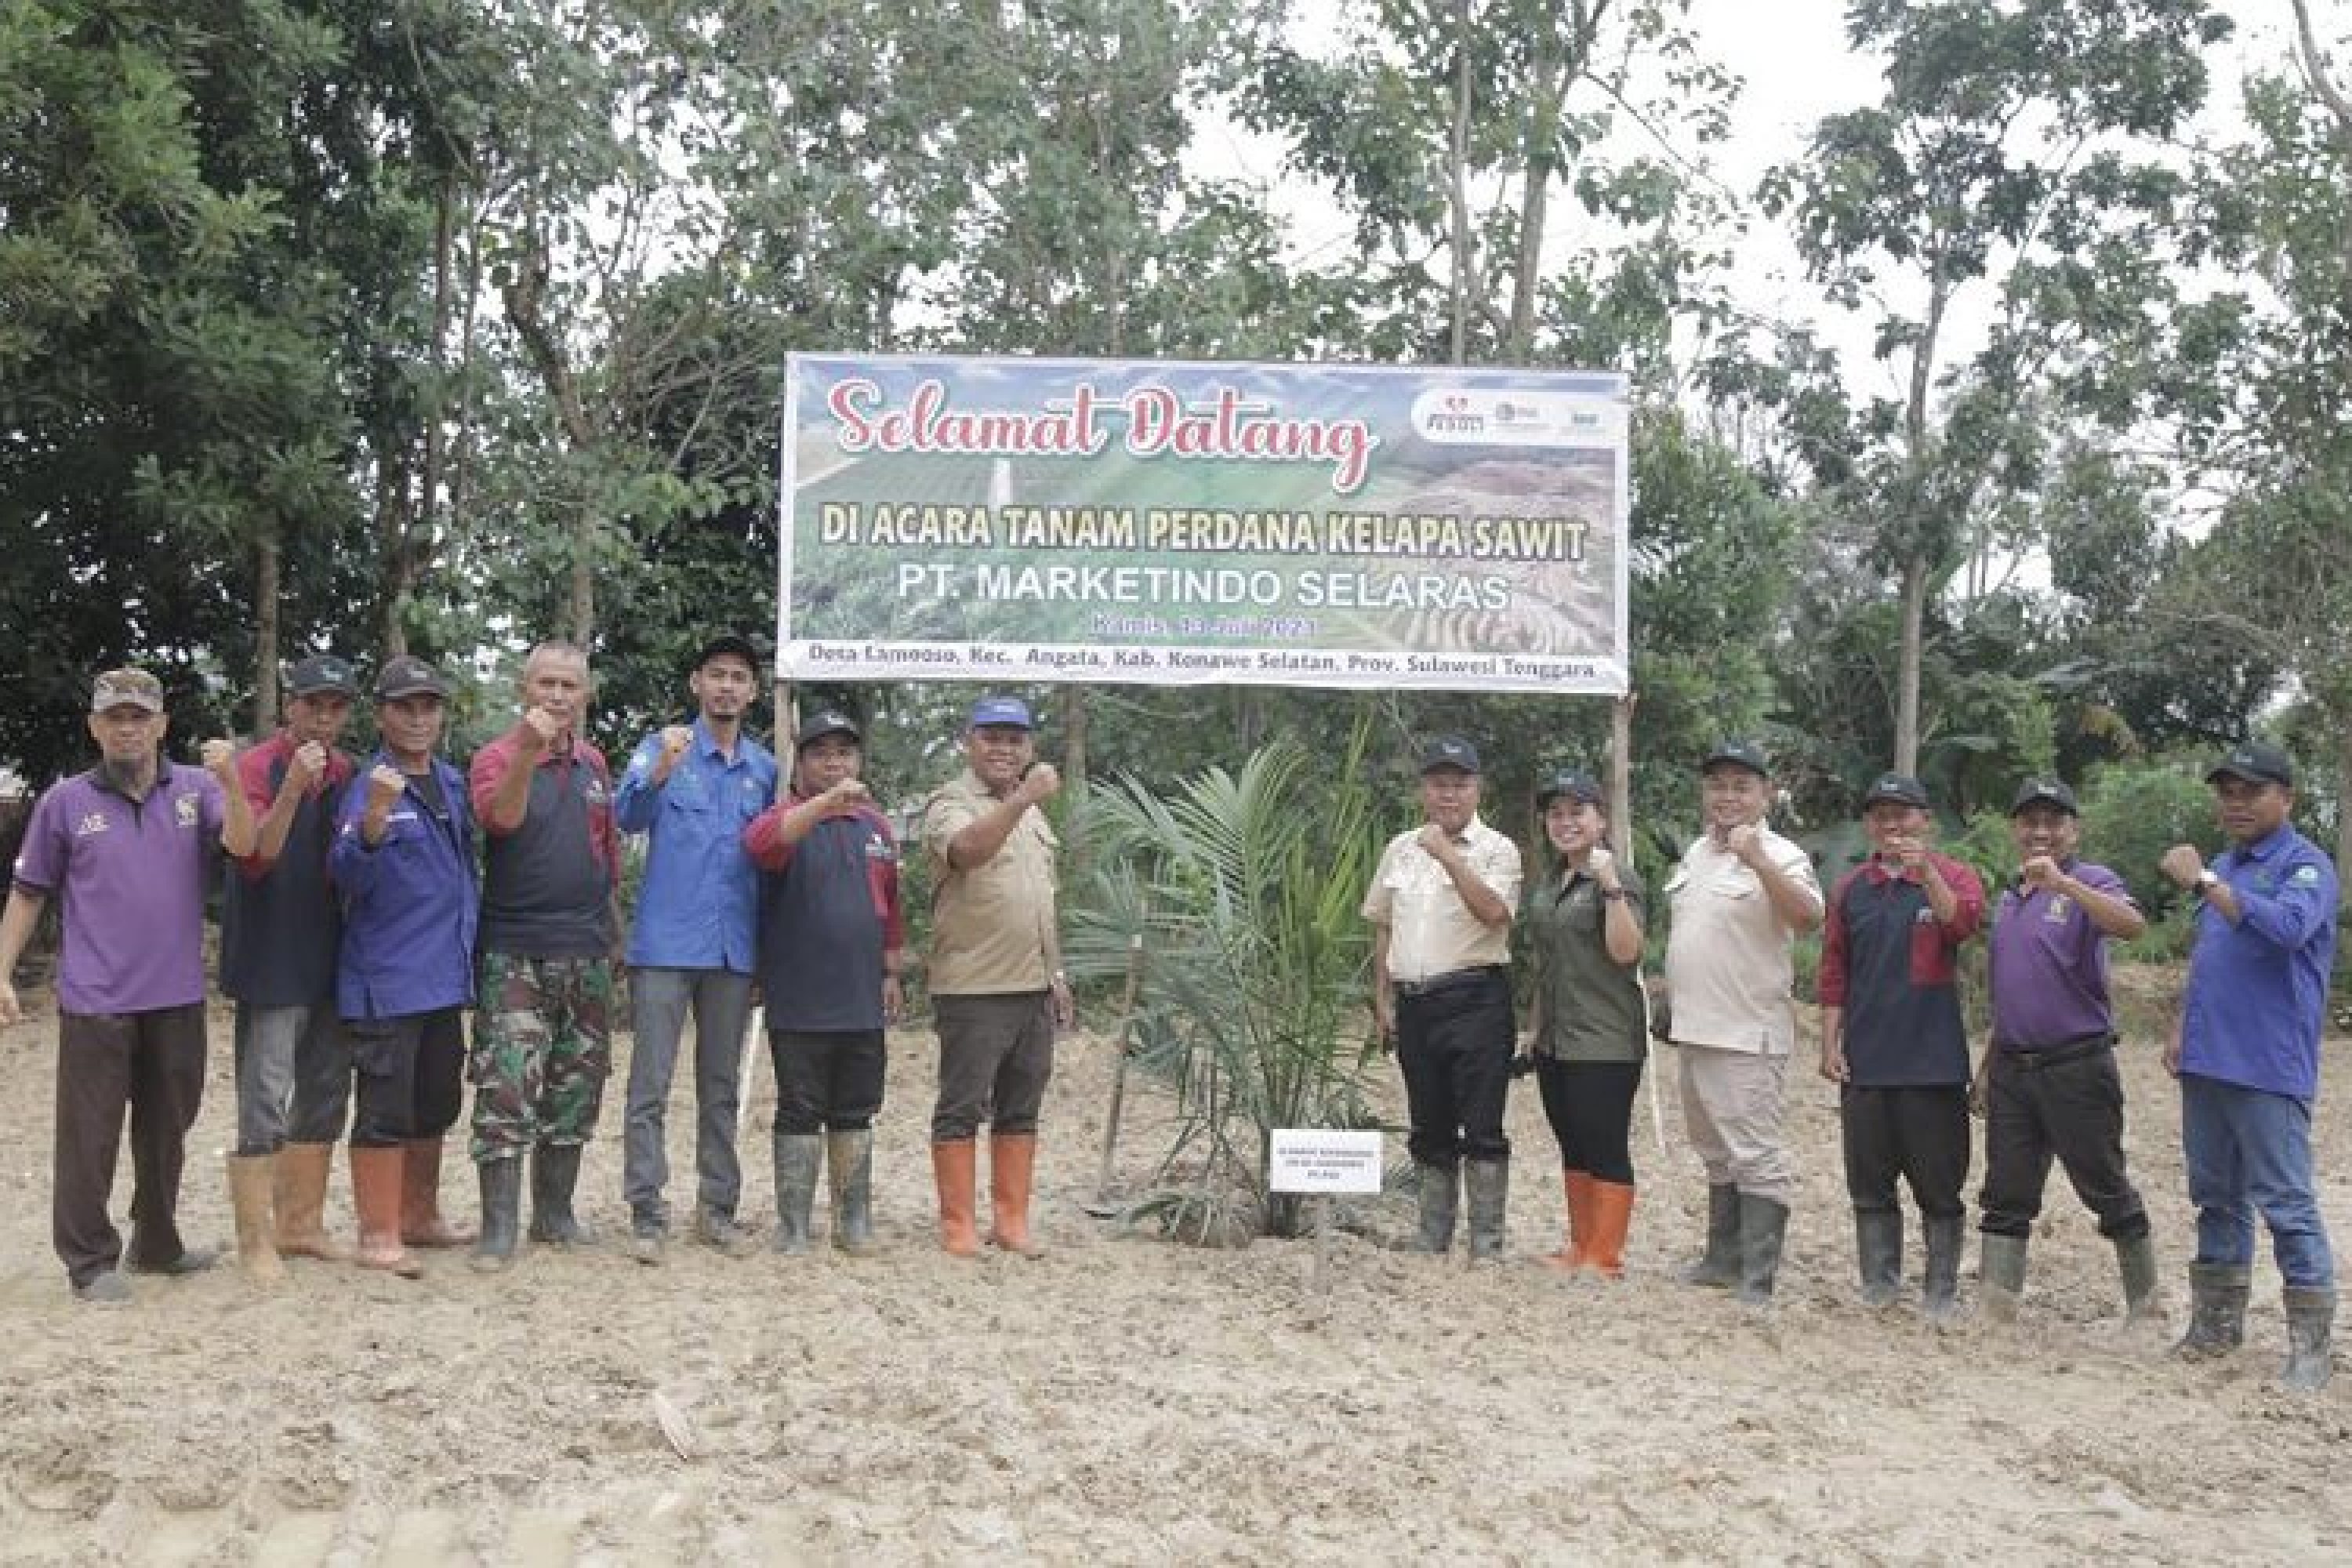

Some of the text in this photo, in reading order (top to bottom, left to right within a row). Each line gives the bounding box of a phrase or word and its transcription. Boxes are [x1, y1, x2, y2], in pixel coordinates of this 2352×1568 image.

[828, 379, 1380, 493] Selamat Datang
[821, 503, 1589, 560] DI ACARA TANAM PERDANA KELAPA SAWIT
[899, 564, 1509, 609] PT. MARKETINDO SELARAS
[1114, 651, 1160, 667] Kab.
[1169, 652, 1251, 669] Konawe
[1408, 655, 1496, 675] Sulawesi
[1504, 659, 1594, 681] Tenggara
